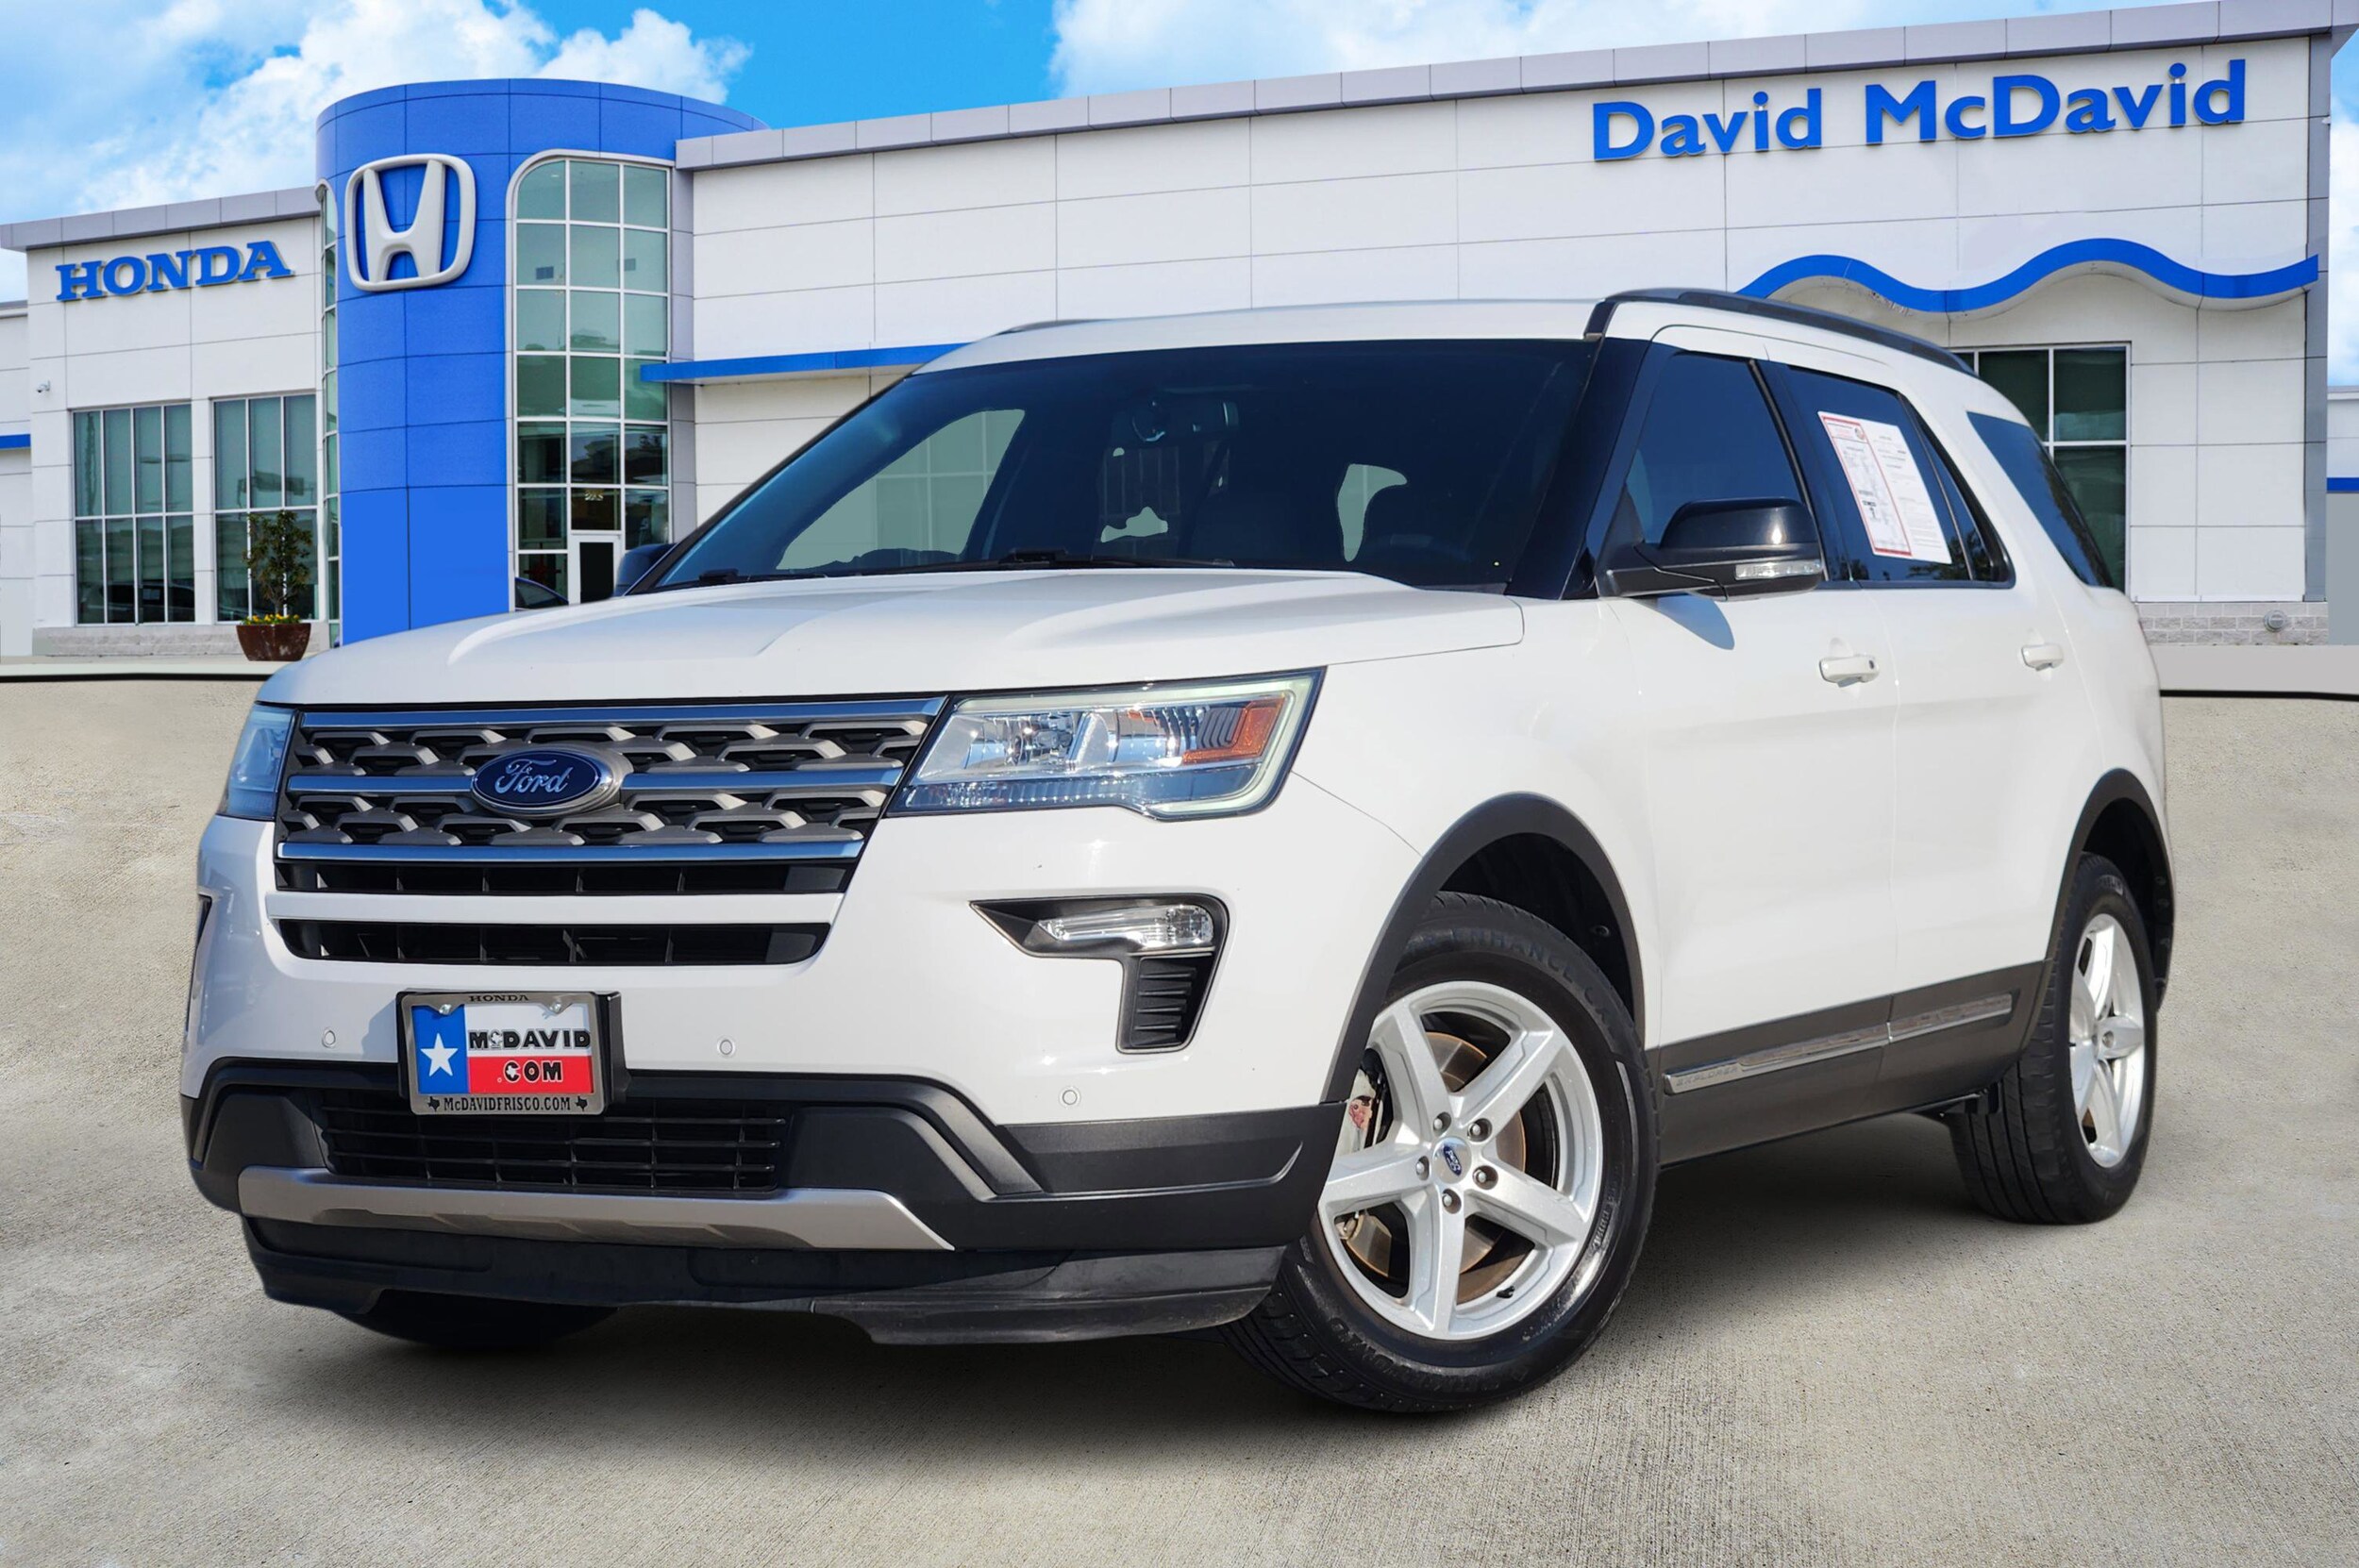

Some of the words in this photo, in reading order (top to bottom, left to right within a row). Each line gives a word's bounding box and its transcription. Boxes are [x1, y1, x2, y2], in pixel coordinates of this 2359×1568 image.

[1593, 88, 1822, 162] David
[1865, 58, 2246, 144] McDavid
[55, 240, 294, 302] HONDA
[494, 759, 574, 794] Ford
[468, 993, 529, 1003] HONDA
